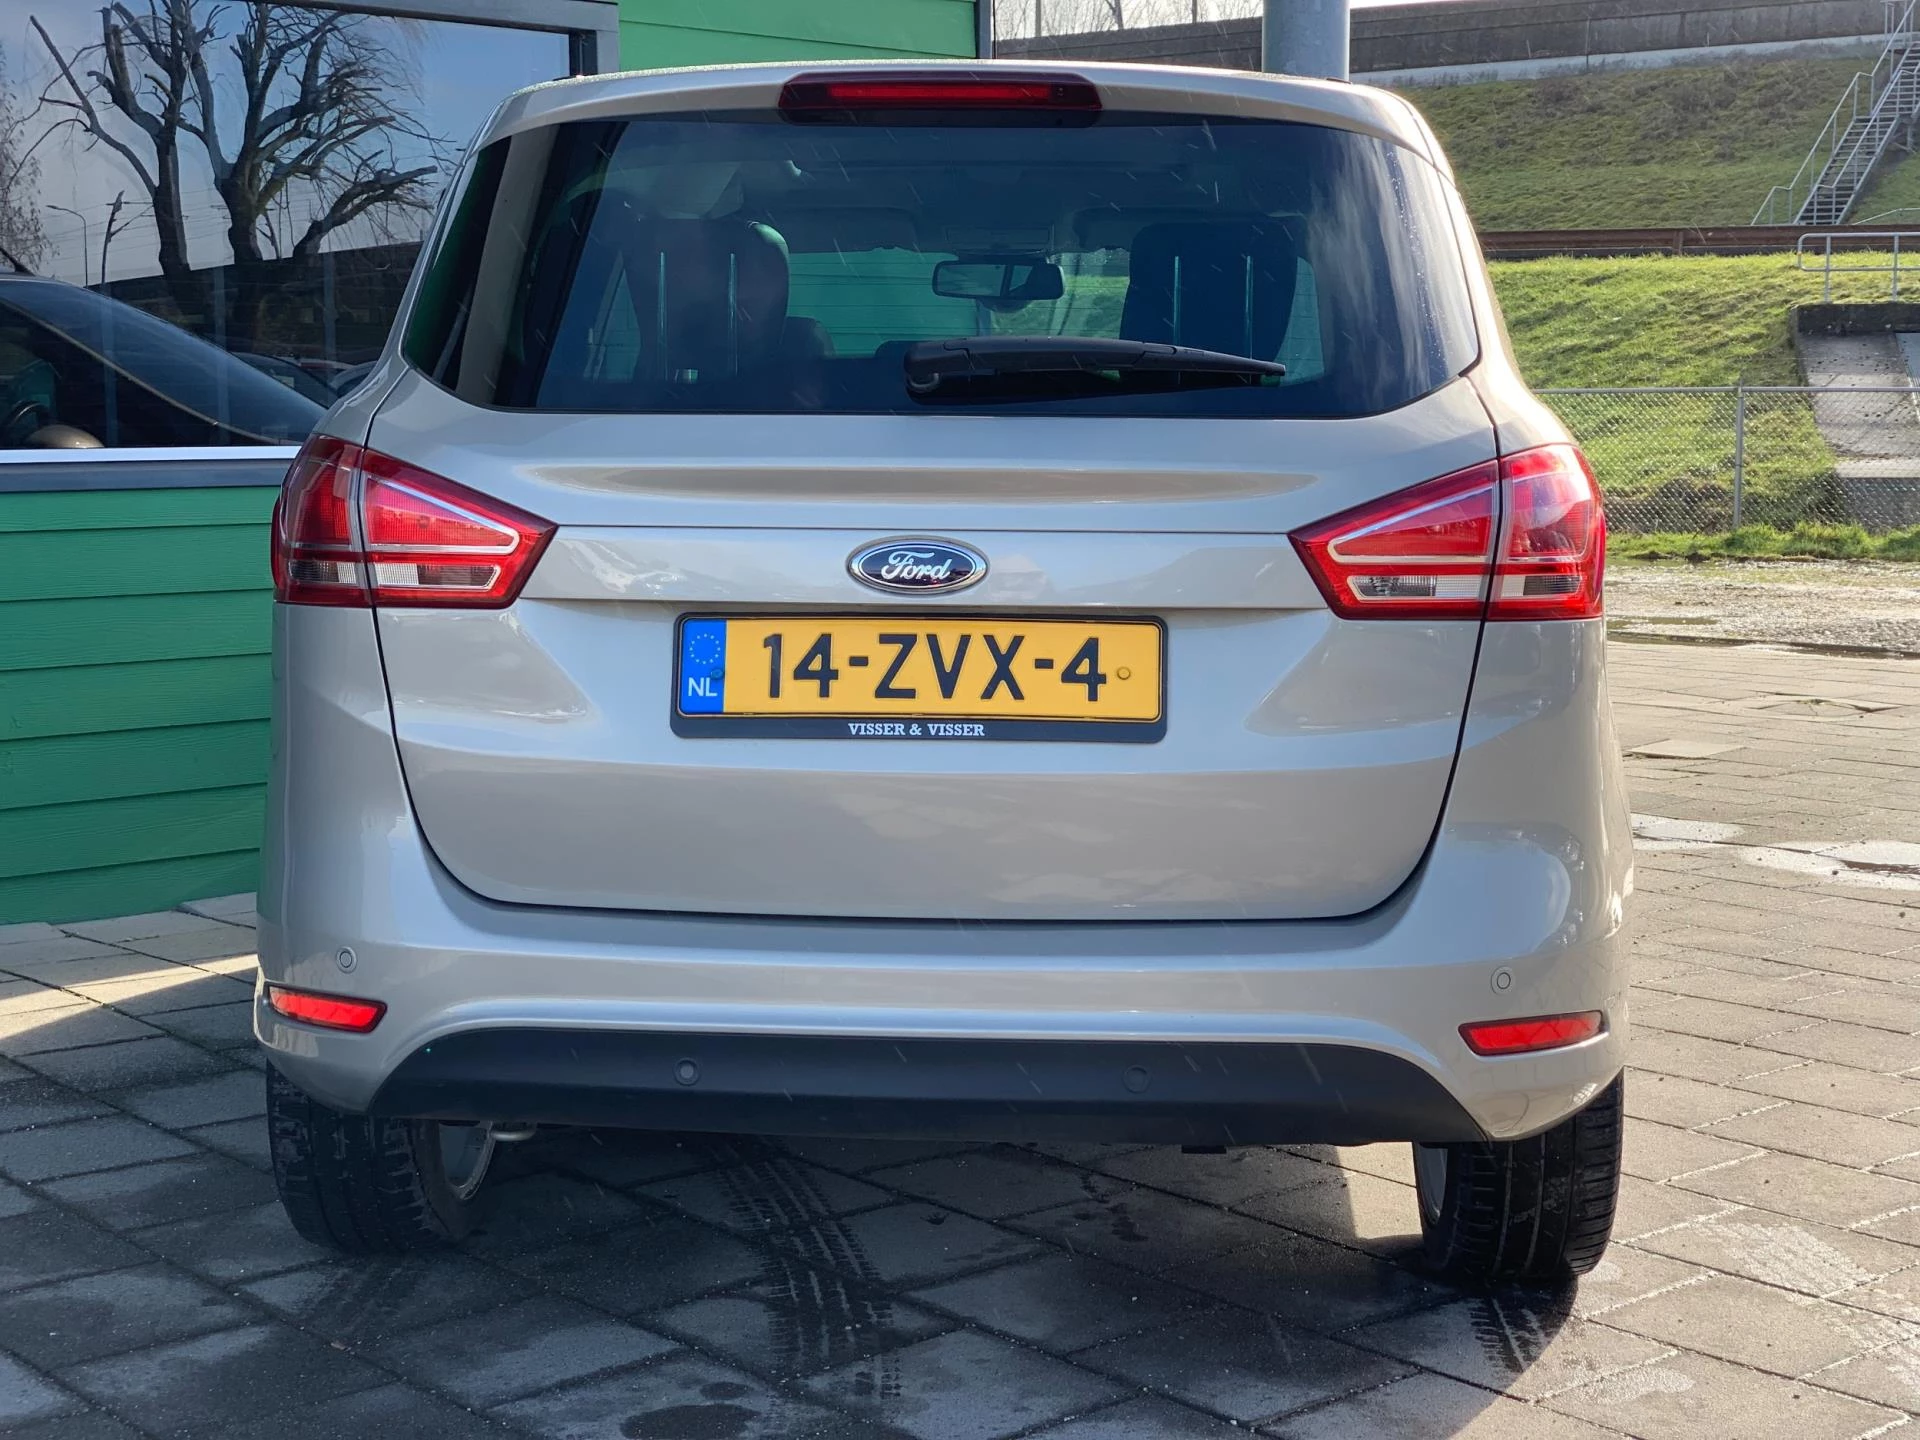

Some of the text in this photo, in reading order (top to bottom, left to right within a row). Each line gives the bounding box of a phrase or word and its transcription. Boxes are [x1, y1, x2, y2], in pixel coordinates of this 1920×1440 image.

[880, 550, 952, 580] Ford
[763, 633, 1107, 701] 14-ZVX-4
[687, 677, 718, 697] NL
[848, 723, 985, 736] VISSER & VISSER
